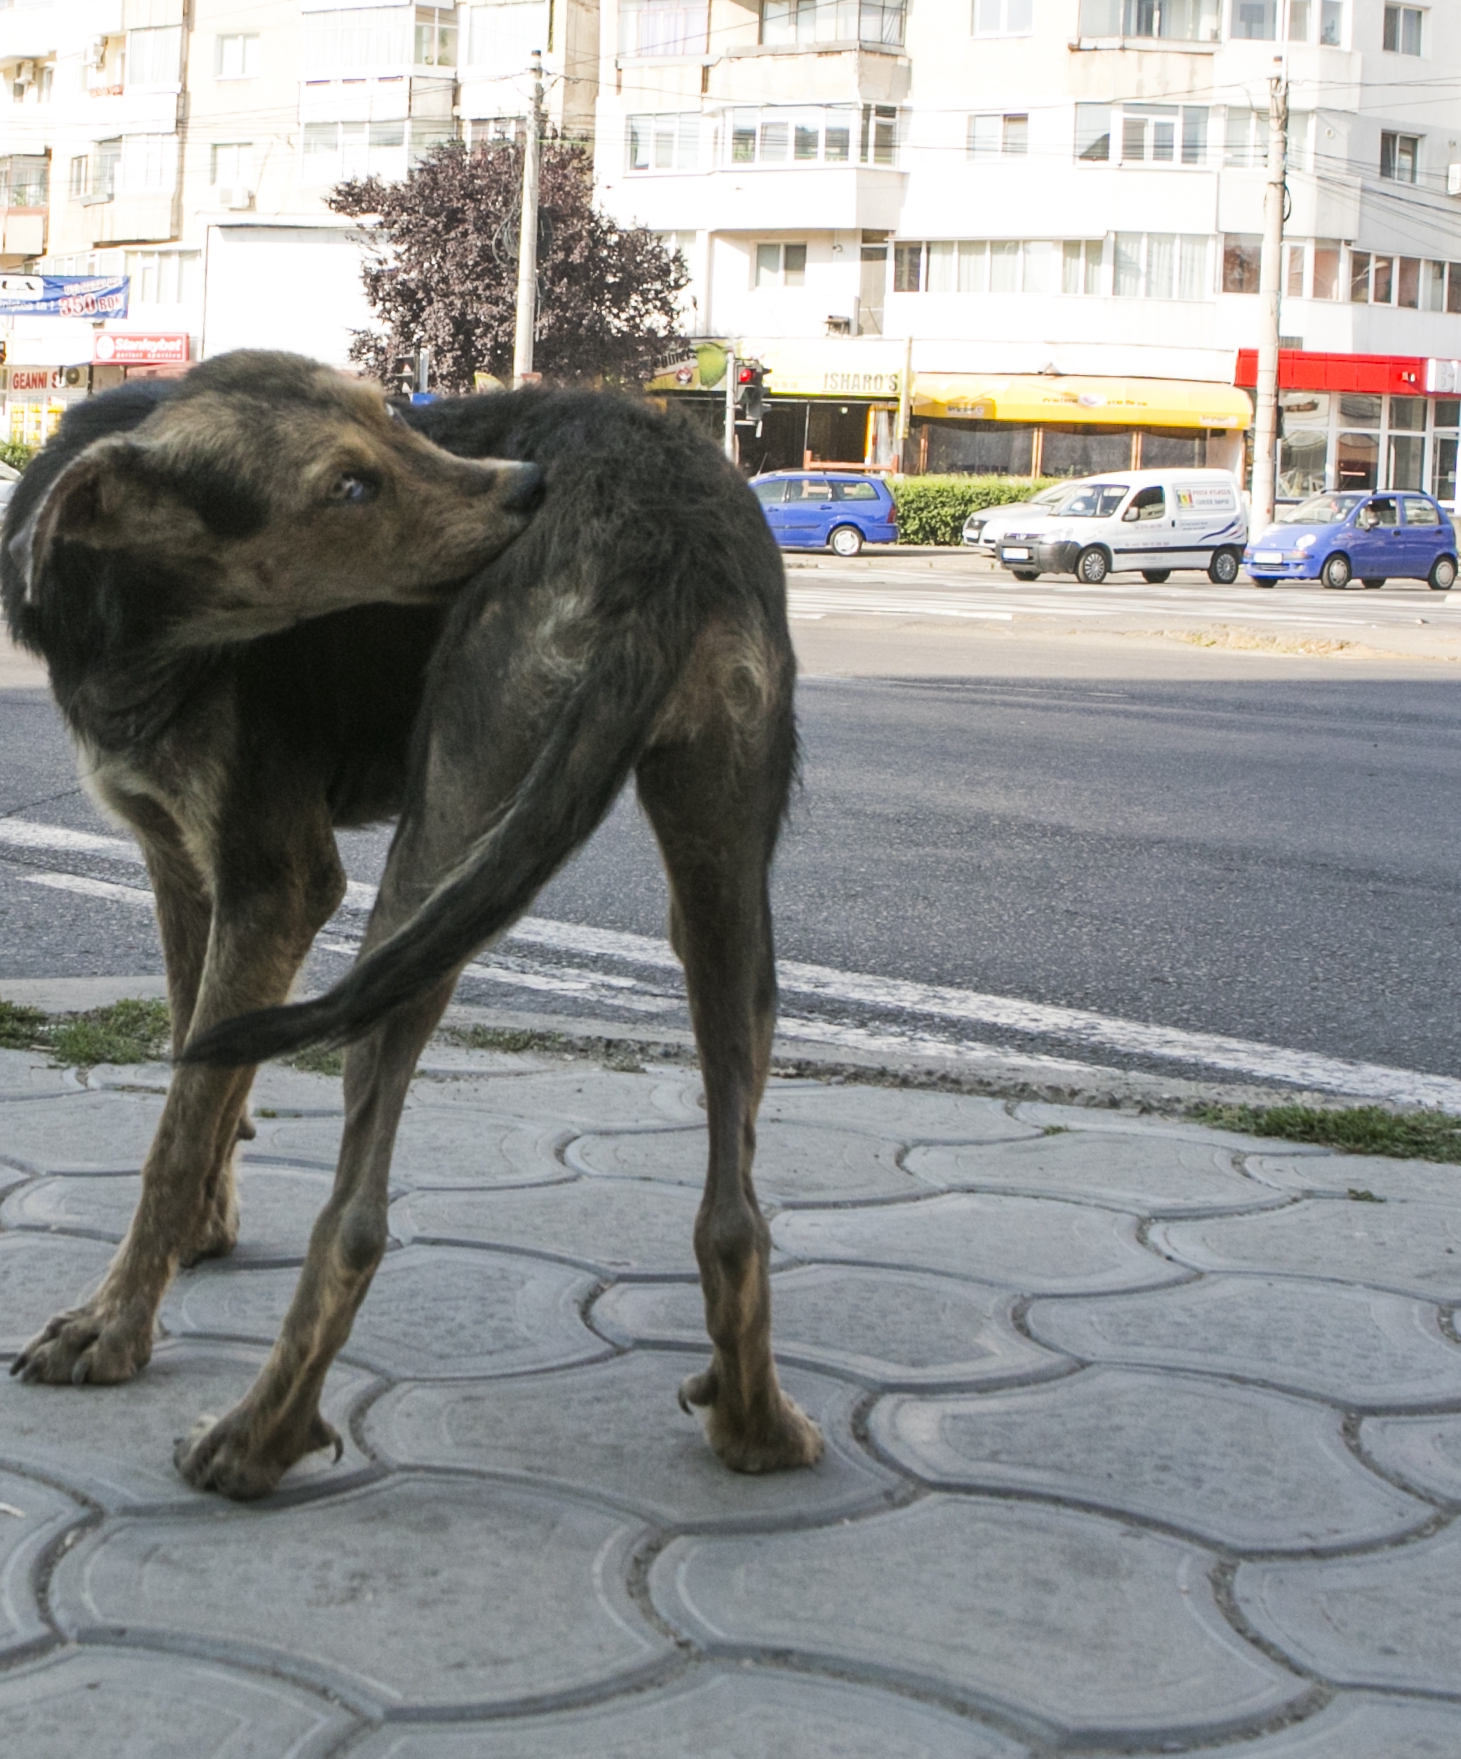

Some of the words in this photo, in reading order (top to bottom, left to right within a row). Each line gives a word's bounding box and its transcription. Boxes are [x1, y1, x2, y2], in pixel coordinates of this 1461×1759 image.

[59, 294, 96, 316] 350
[98, 294, 124, 312] RON
[115, 337, 183, 353] Stanleybet
[13, 372, 47, 390] GEANNI
[823, 372, 899, 392] ISHARO'S
